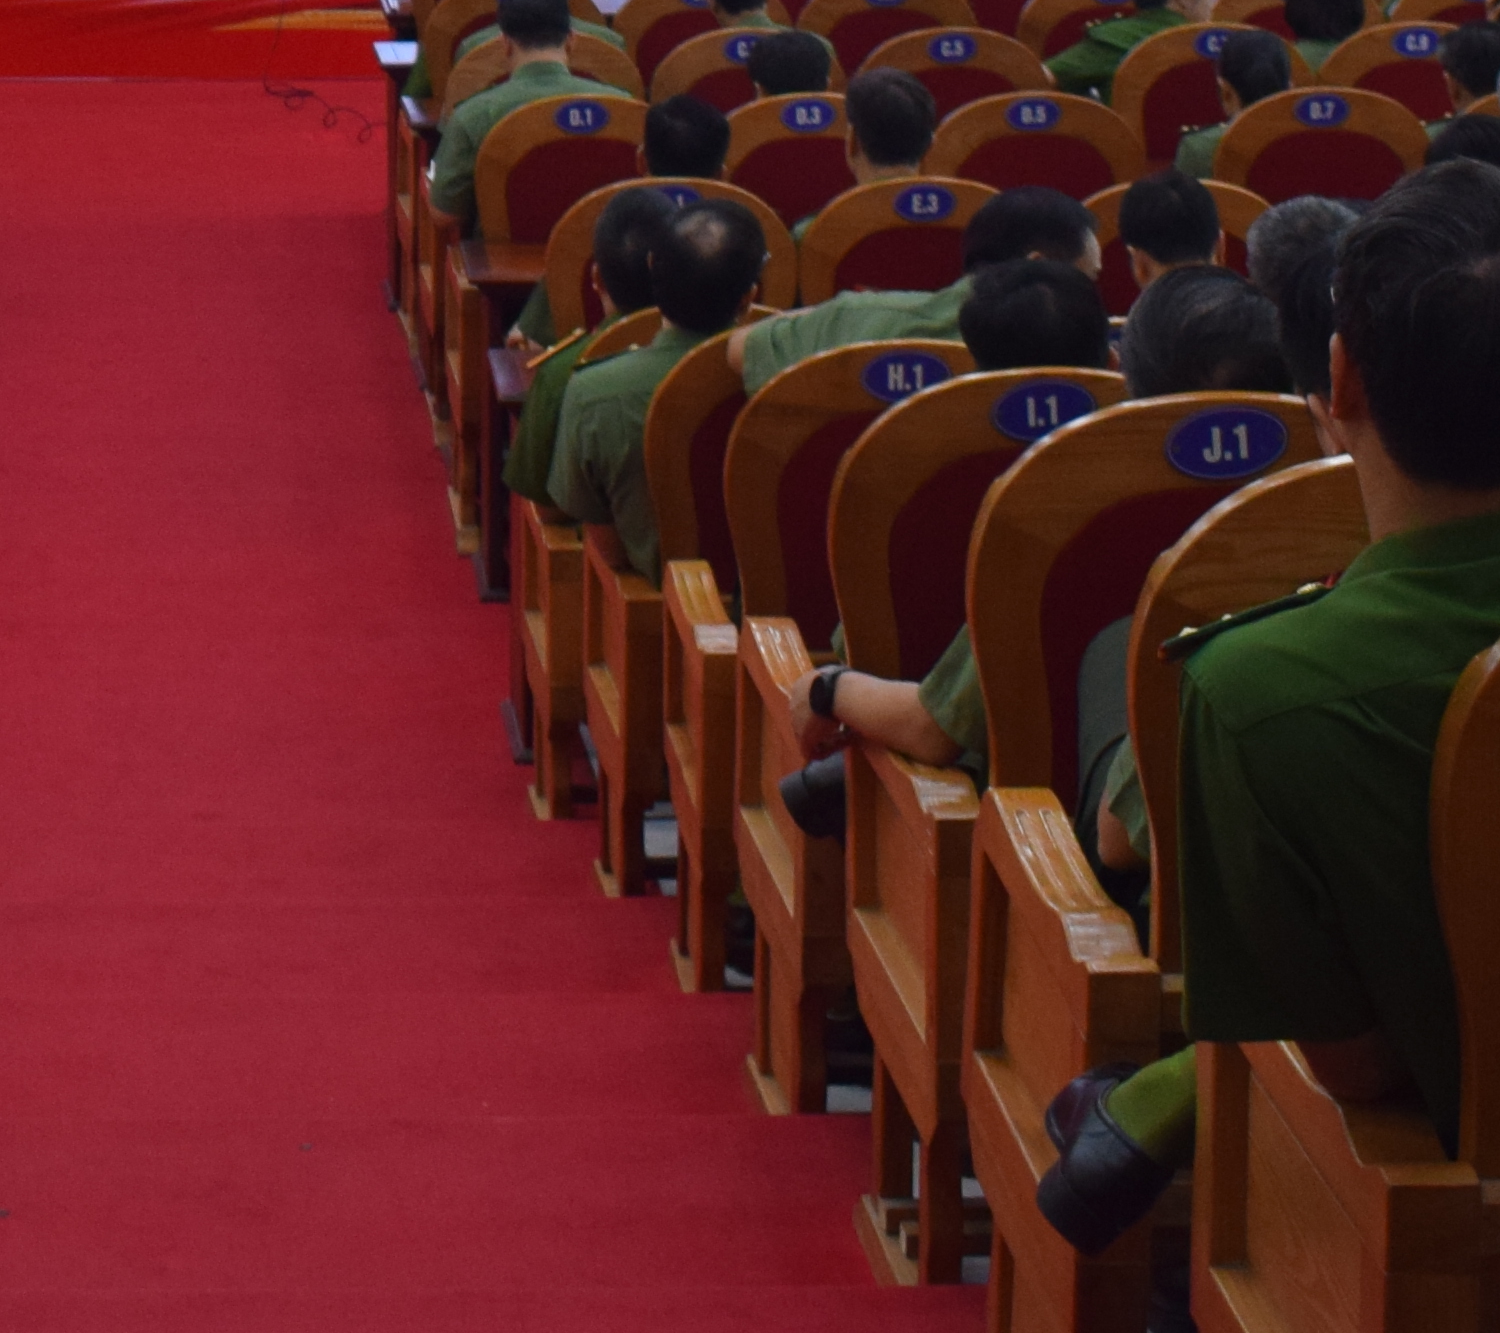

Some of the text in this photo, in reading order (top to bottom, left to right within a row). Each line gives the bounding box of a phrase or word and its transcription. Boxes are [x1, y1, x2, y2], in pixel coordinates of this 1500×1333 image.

[888, 363, 924, 392] H.1
[1027, 395, 1059, 427] I.1
[1203, 425, 1248, 462] J.1
